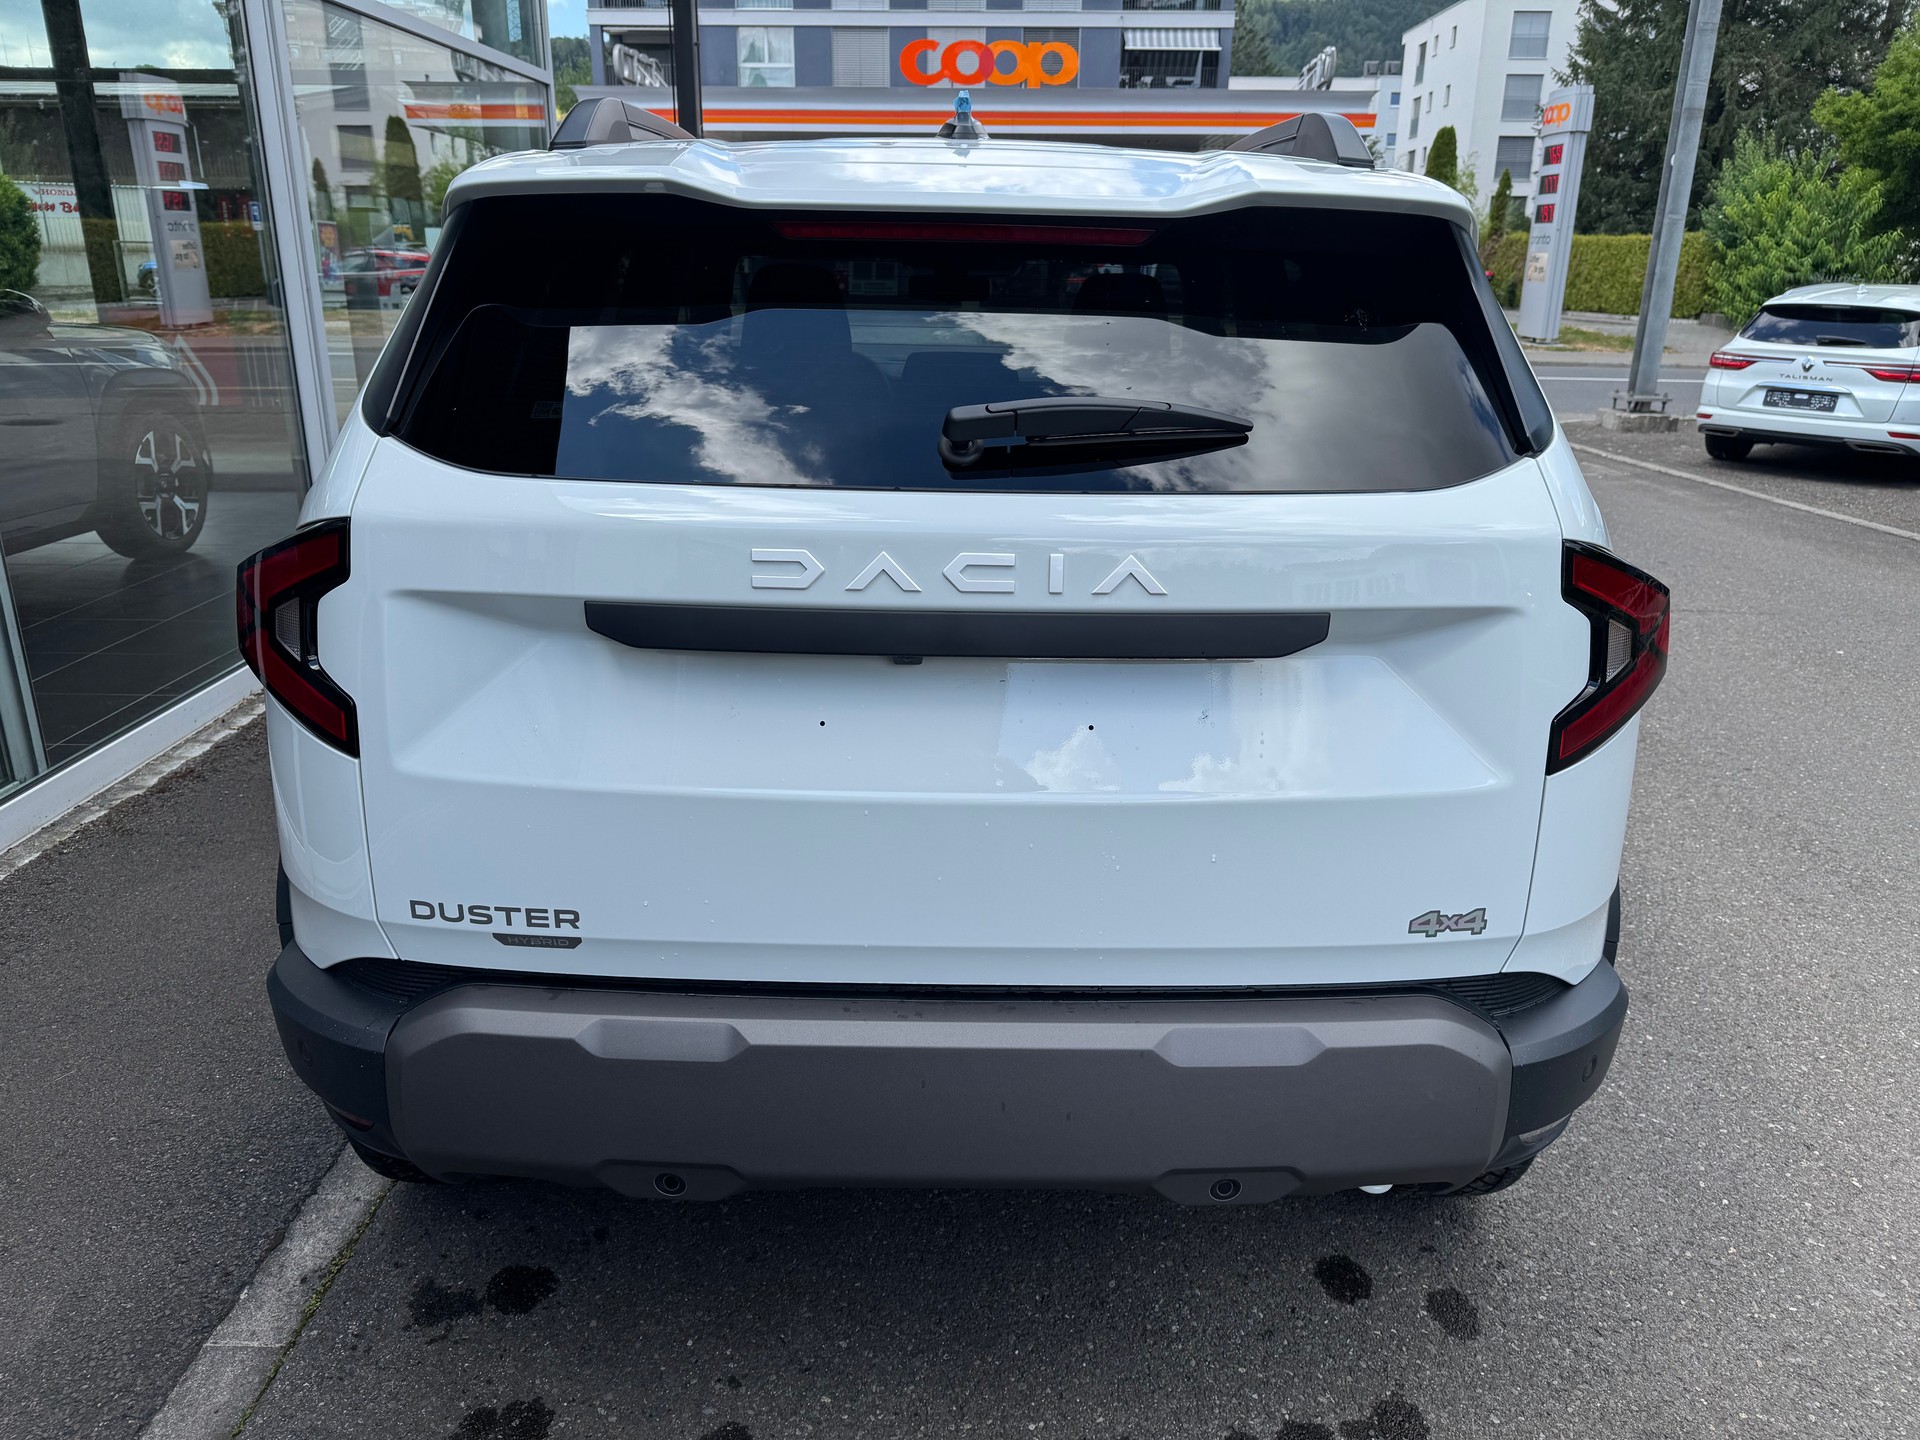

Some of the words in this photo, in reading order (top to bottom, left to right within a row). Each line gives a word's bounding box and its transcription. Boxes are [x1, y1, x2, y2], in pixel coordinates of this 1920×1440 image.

[899, 38, 1079, 89] coop
[40, 188, 79, 197] HOND
[1779, 373, 1834, 382] TALISMAN
[751, 547, 1169, 597] DACIA
[409, 899, 581, 931] DUSTER
[1407, 907, 1488, 938] 4x4
[507, 935, 570, 947] HYBRID
